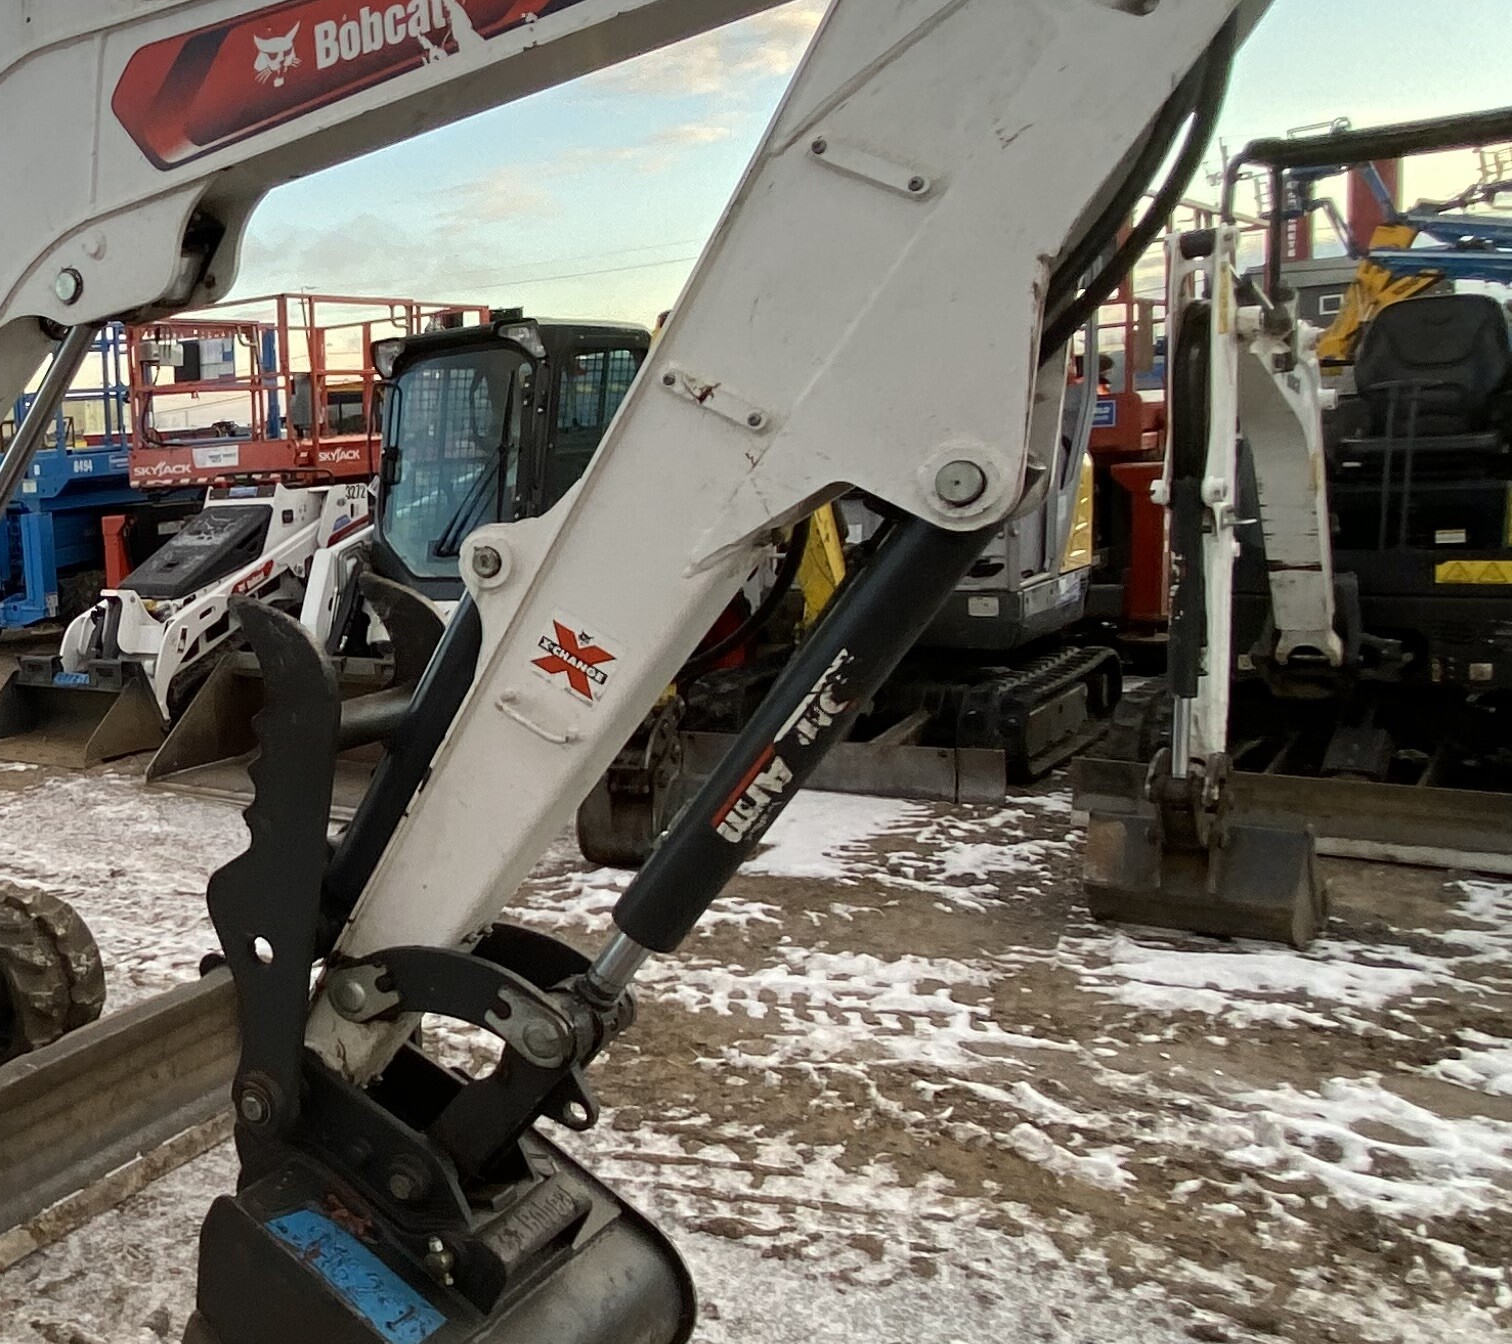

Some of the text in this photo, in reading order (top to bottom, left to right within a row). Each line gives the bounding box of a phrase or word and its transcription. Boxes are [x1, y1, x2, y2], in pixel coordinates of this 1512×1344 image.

[318, 447, 362, 463] SKYJACK
[133, 461, 191, 477] SKYJACK
[345, 484, 366, 500] 3272
[539, 636, 607, 685] X-CHANGE
